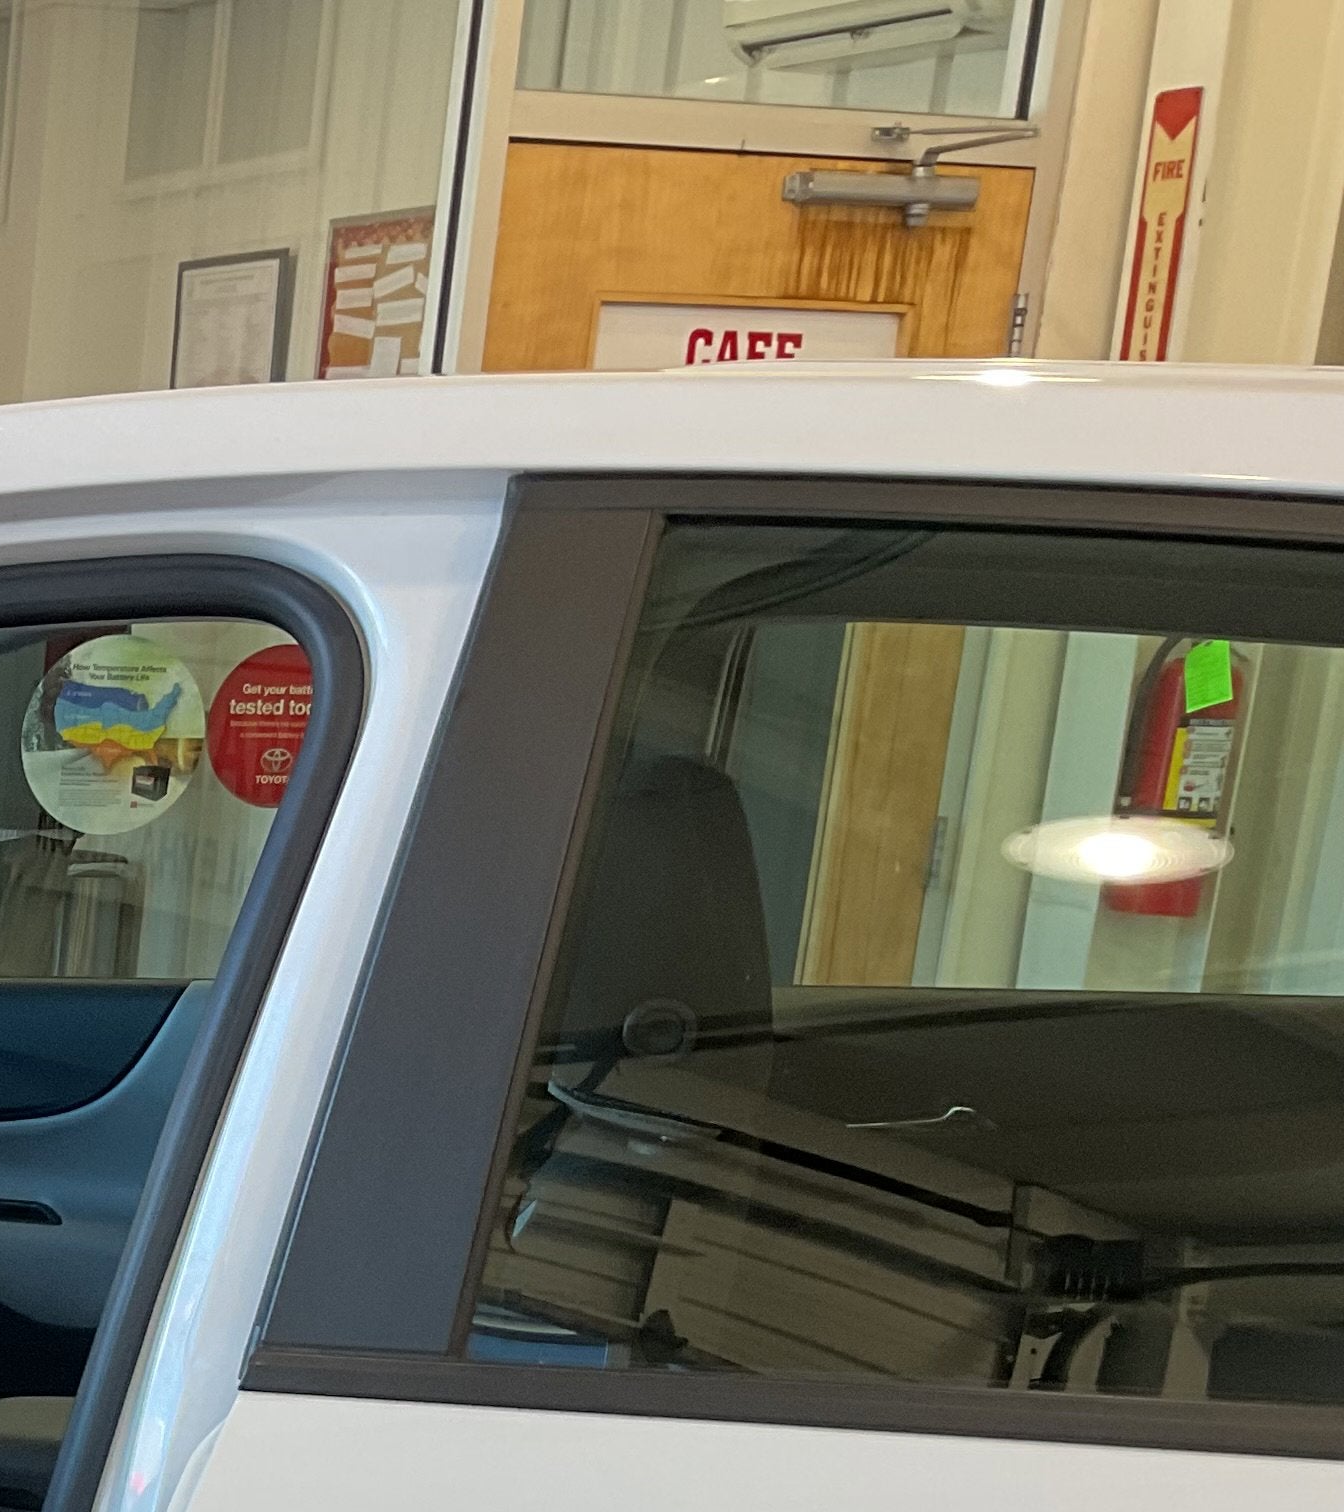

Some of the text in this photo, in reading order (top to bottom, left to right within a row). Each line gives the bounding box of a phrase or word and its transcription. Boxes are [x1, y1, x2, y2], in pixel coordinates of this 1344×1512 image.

[1153, 160, 1185, 182] FIRE
[1139, 212, 1167, 362] EXTINGUIS
[73, 663, 90, 671] How
[93, 663, 139, 674] Temperature
[89, 672, 105, 681] Your
[107, 673, 134, 682] Battery
[243, 683, 261, 694] Get
[263, 686, 287, 697] your
[230, 699, 285, 715] tested
[255, 775, 289, 784] TOYOT
